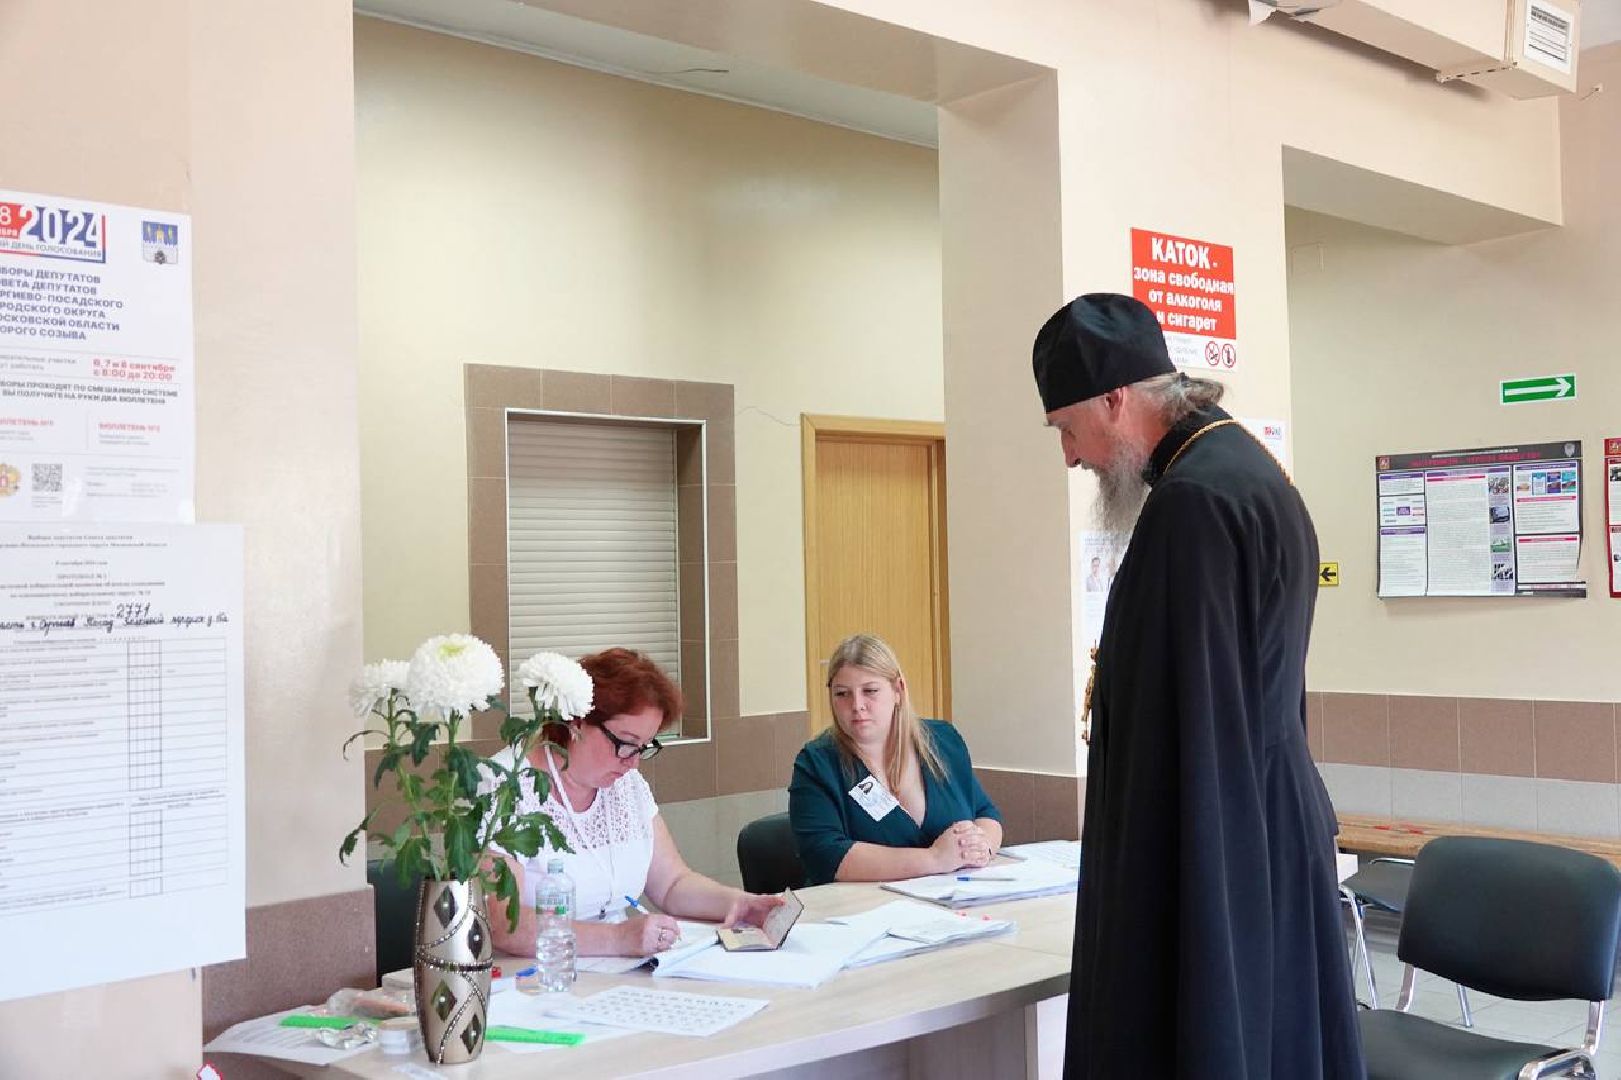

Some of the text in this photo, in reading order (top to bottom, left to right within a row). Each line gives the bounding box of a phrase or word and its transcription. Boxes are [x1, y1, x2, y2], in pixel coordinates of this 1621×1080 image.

[0, 205, 101, 249] 8 2024
[1151, 237, 1211, 270] КАТОК
[36, 269, 101, 284] ДЕПУТАТОВ
[1133, 266, 1235, 295] зона свободная
[0, 278, 97, 295] ВЕТА ДЕПУТАТОВ
[1148, 289, 1223, 312] от алкоголя
[64, 306, 106, 319] ОКРУГА
[68, 318, 121, 332] ОБЛАСТИ
[1167, 312, 1218, 332] сигарет
[39, 328, 87, 341] СОЗЫВА
[116, 602, 151, 618] 2771
